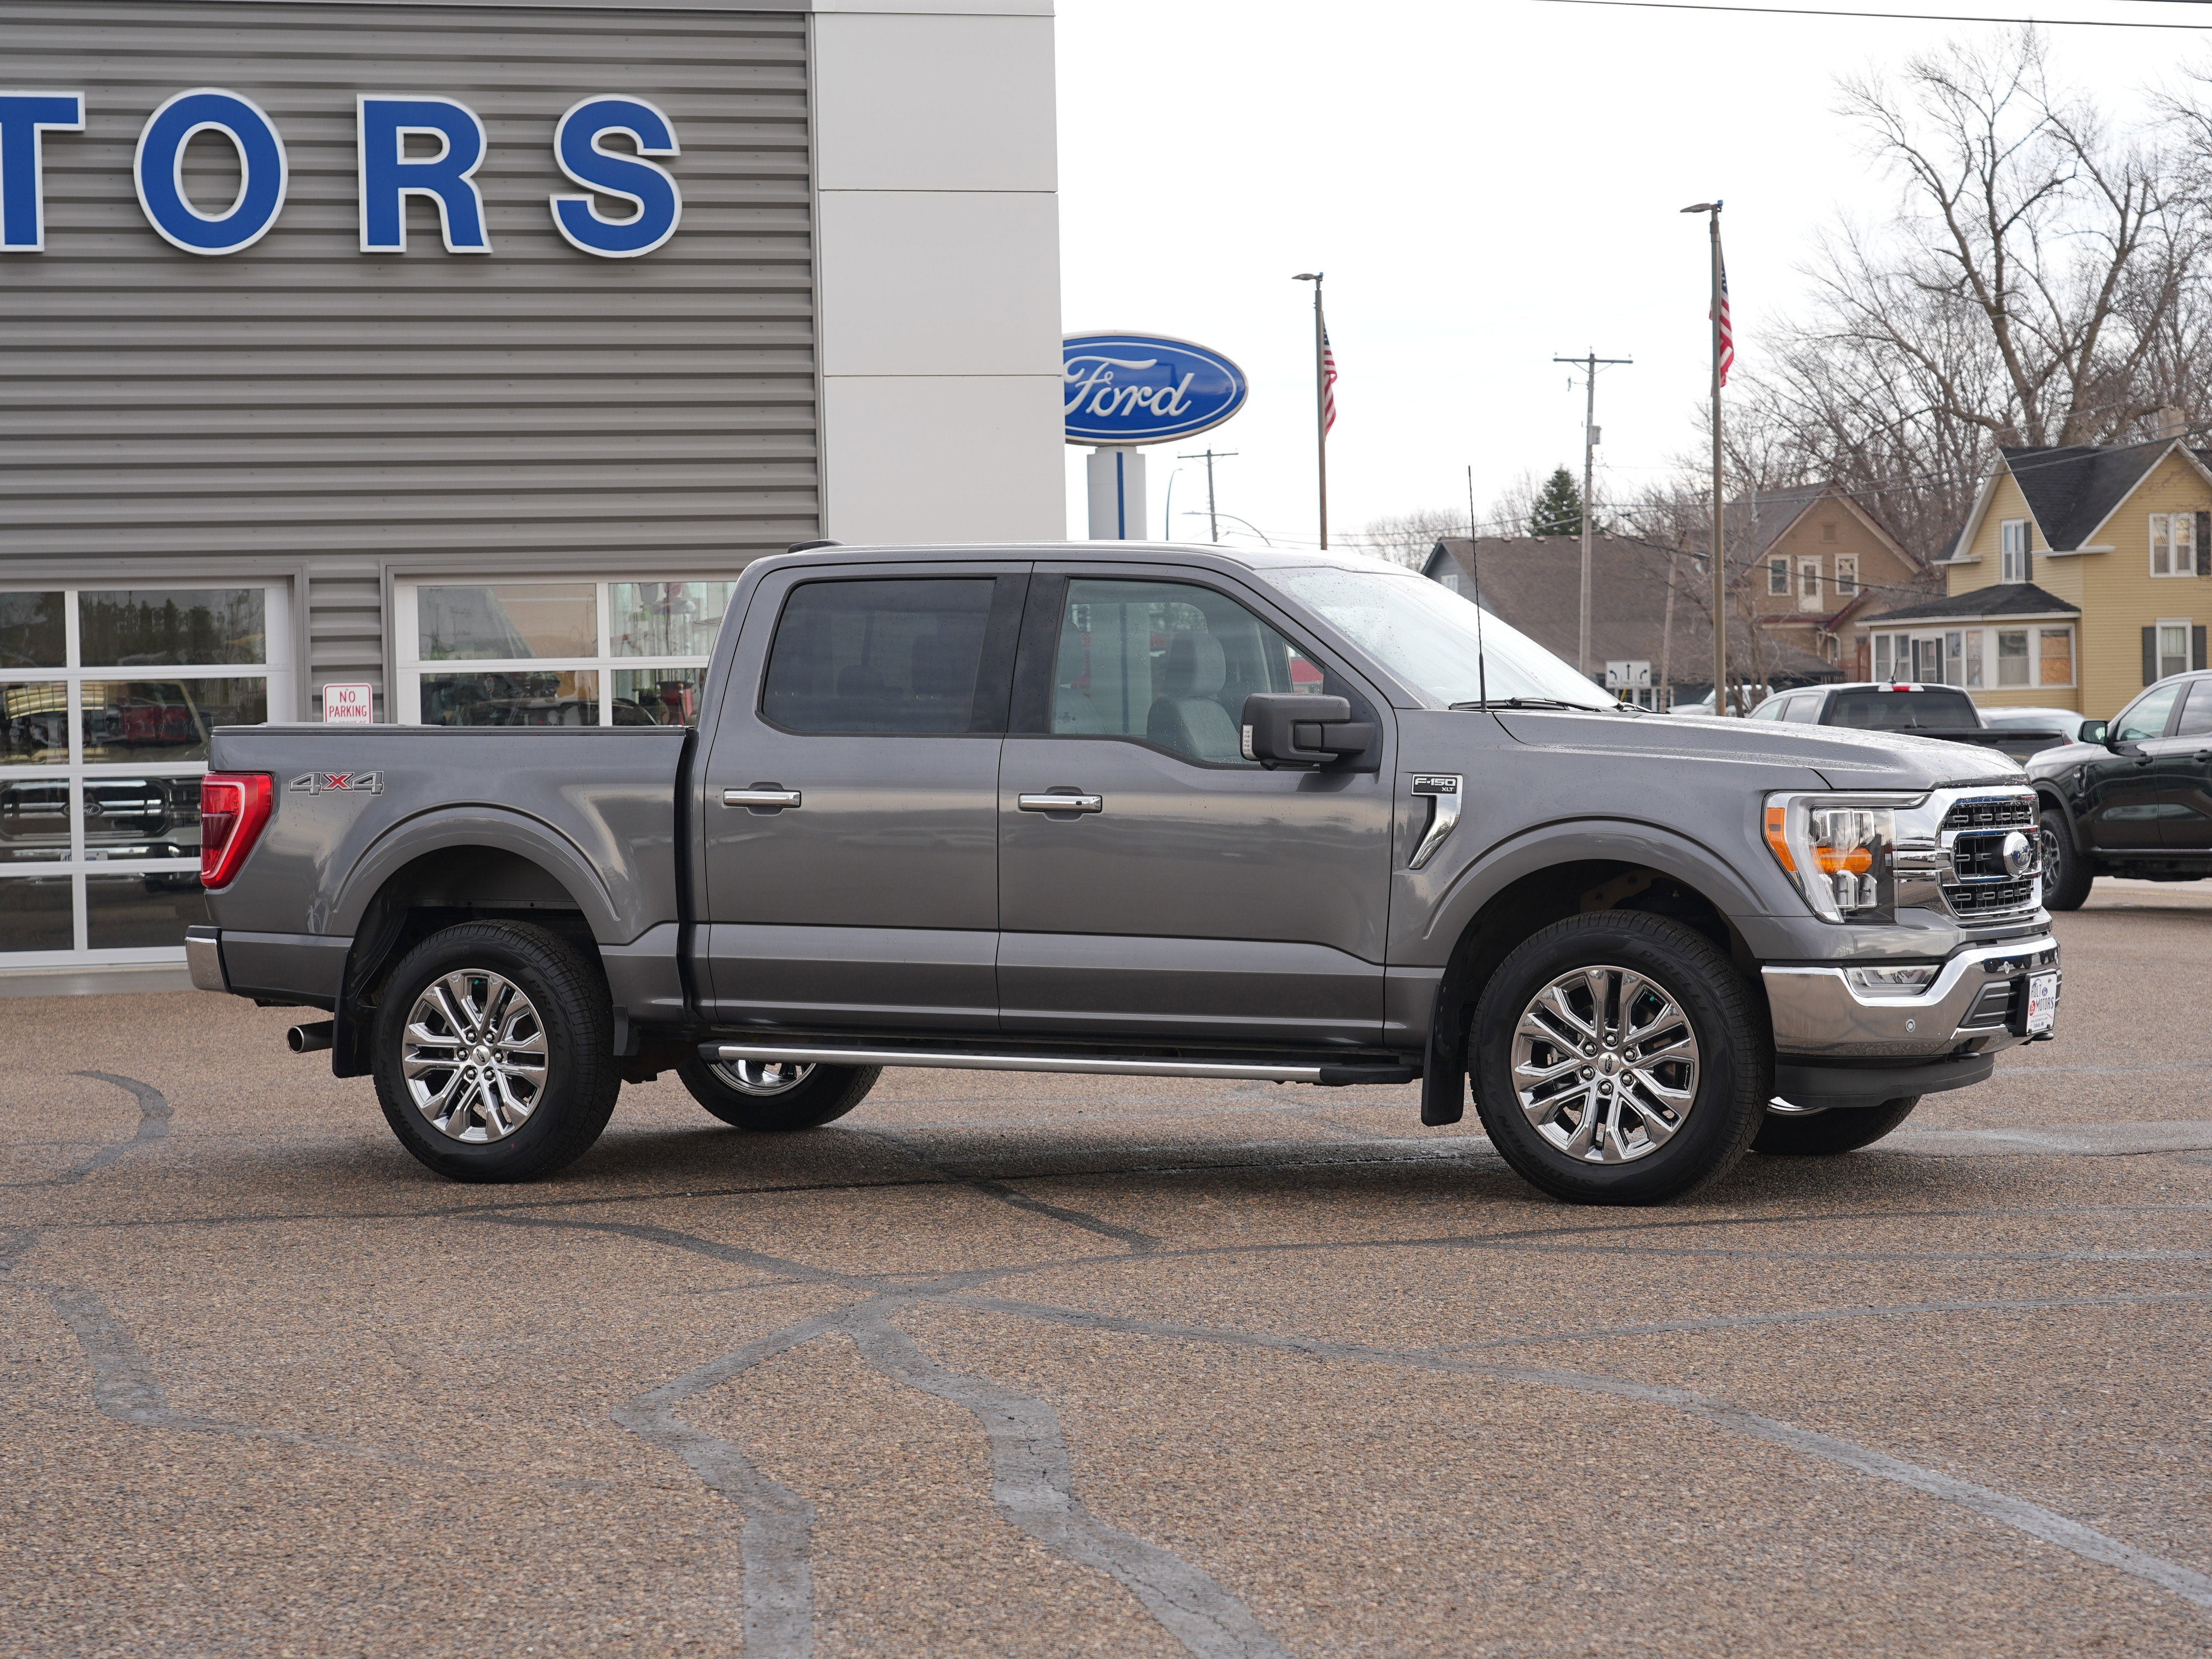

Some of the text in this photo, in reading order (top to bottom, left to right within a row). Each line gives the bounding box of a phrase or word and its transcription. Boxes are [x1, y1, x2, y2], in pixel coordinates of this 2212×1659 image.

[0, 87, 682, 258] TORS
[1064, 355, 1195, 417] Ford
[340, 691, 355, 703] NO
[329, 705, 367, 717] PARKING
[1415, 778, 1456, 786] F-150
[1638, 949, 1708, 1011] PIRELLI
[2031, 984, 2041, 999] HOLT
[2036, 996, 2054, 1012] MOTORS
[528, 980, 564, 1051] PIRELLI
